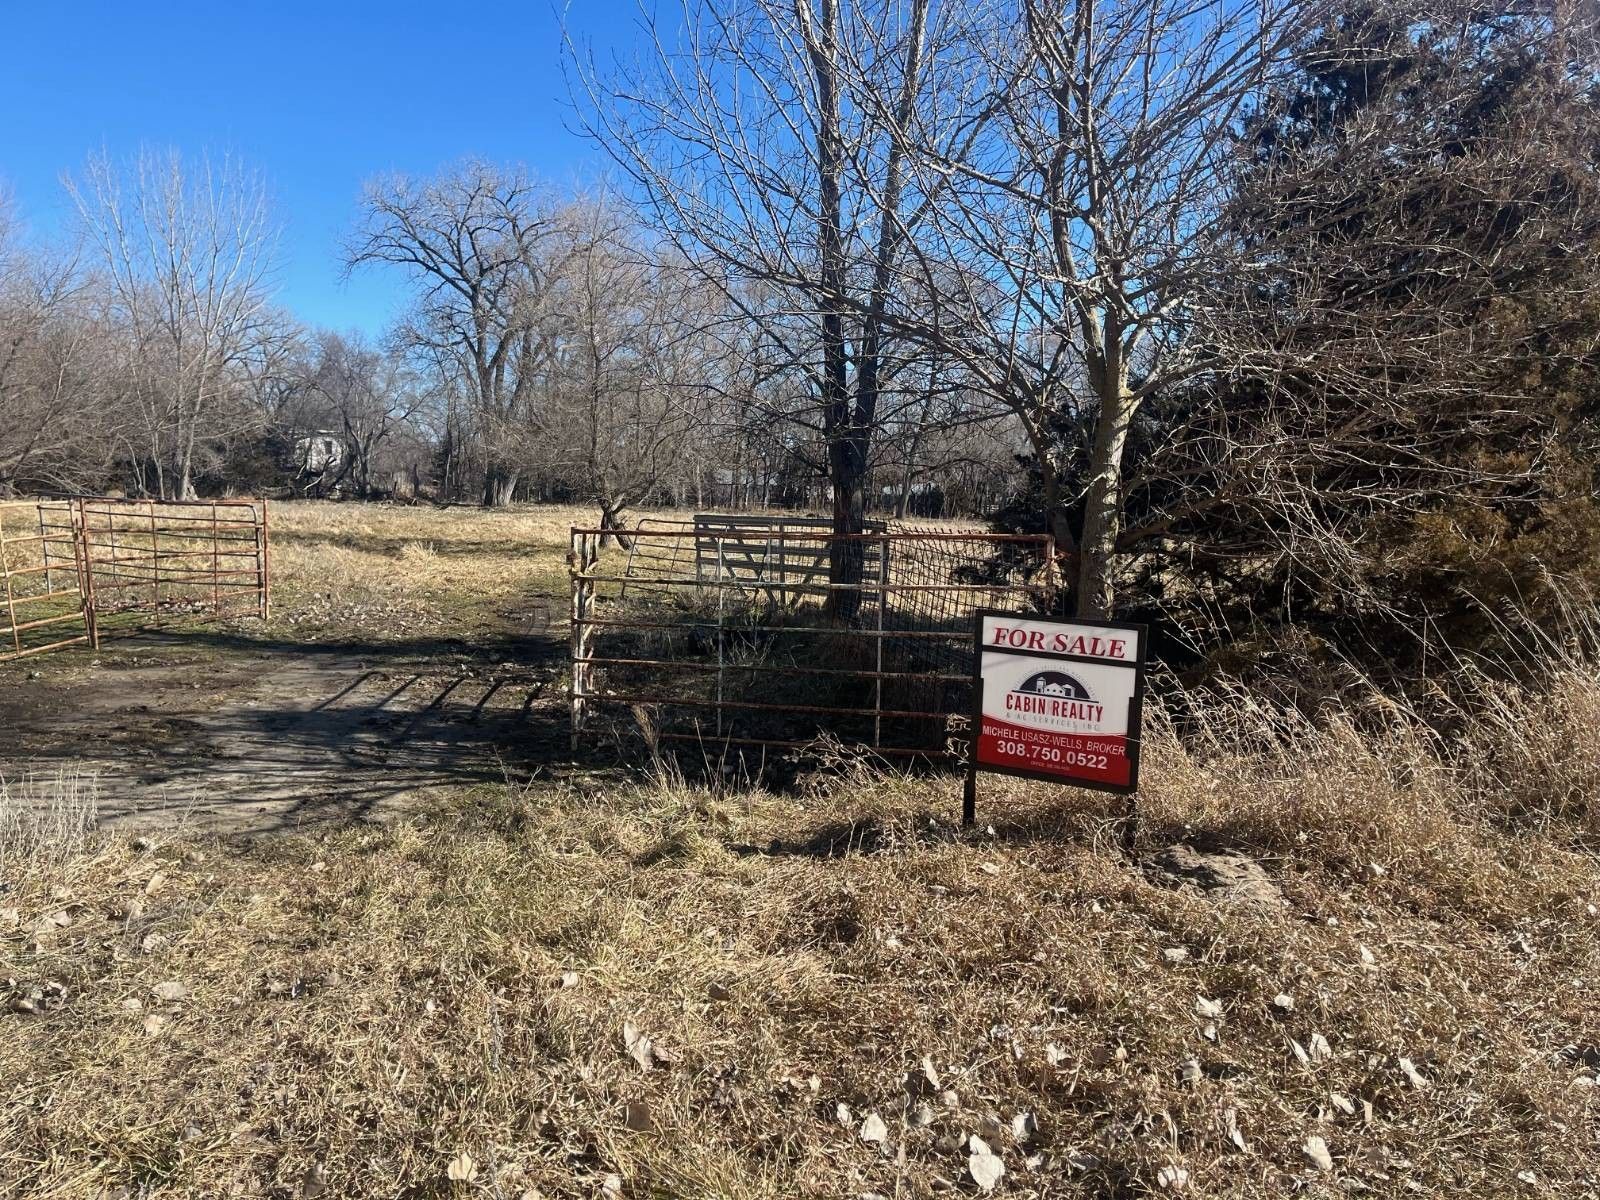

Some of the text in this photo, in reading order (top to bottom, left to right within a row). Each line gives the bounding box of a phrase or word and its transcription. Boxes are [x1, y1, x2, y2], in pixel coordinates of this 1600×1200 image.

[993, 627, 1126, 659] FOR SALE
[1006, 694, 1104, 722] CABIN REALTY
[1033, 716, 1077, 729] SERVICES
[982, 725, 1020, 740] MICHELE
[1087, 741, 1126, 757] BROKER
[997, 740, 1108, 770] 308.750.0522
